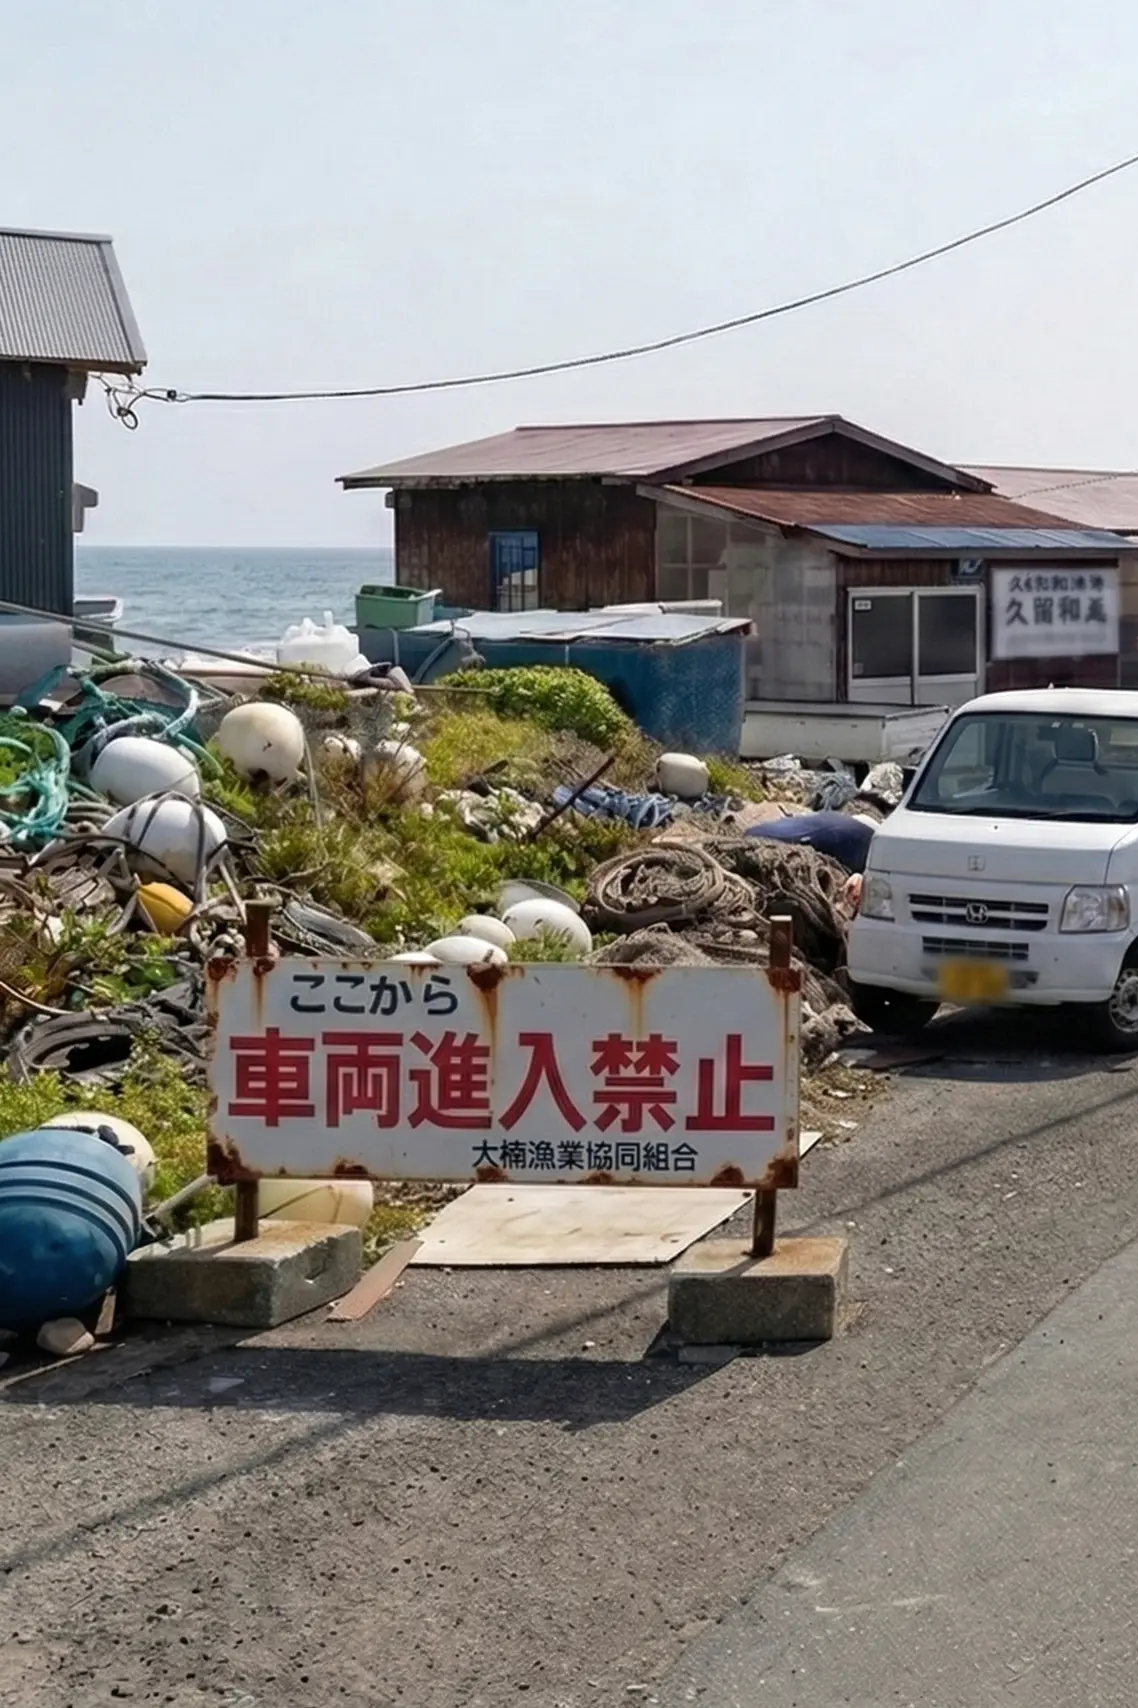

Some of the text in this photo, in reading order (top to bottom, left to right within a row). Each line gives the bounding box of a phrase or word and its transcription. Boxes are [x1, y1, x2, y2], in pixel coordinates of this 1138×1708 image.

[290, 973, 458, 1016] ここから
[228, 1027, 775, 1133] 車両進入禁止
[472, 1139, 699, 1172] 大楠漁業協同組合
